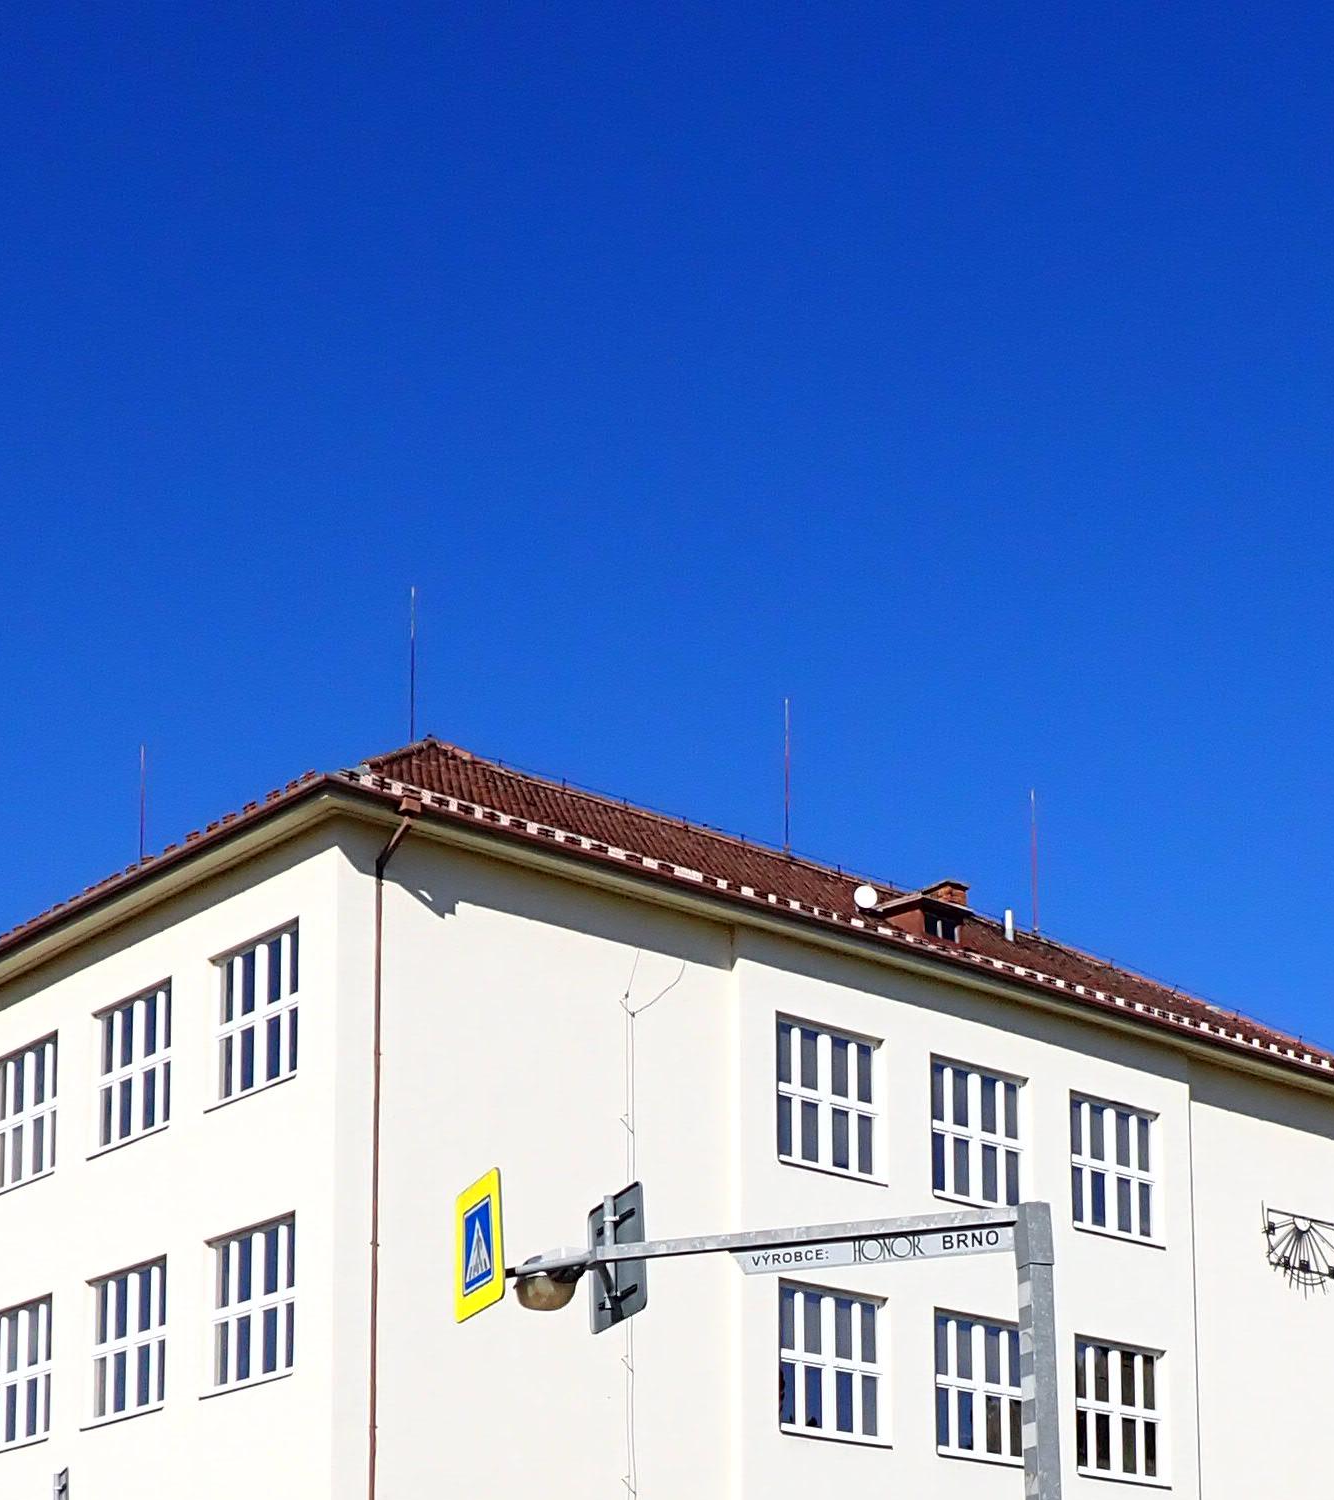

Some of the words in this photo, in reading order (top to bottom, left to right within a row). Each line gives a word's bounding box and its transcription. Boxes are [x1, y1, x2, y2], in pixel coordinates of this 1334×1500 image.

[752, 1248, 829, 1266] VÝROBCE:
[853, 1235, 925, 1262] HONOR
[942, 1230, 1000, 1250] BRNO
